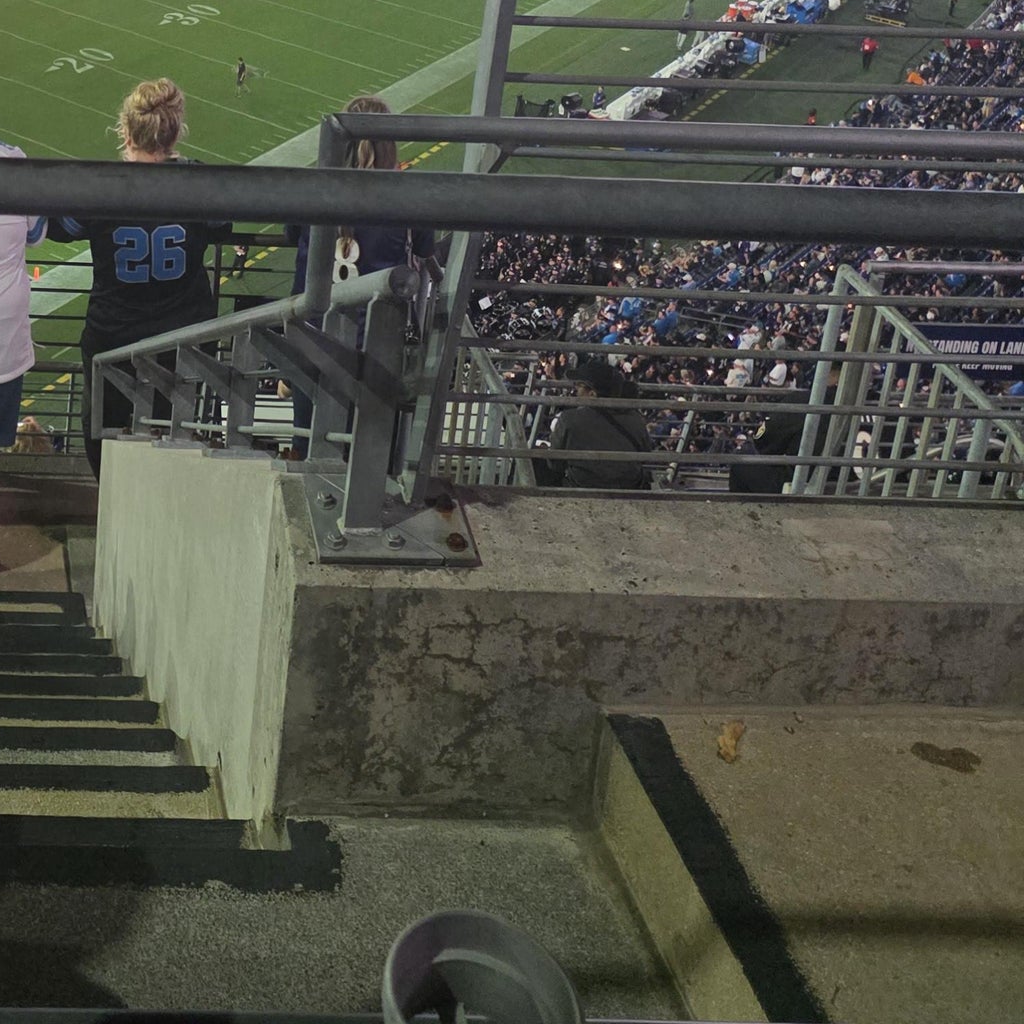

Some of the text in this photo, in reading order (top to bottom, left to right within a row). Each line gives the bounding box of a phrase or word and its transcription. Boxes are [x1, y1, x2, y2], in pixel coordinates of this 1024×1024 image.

[163, 3, 221, 26] 30
[58, 47, 114, 75] 20
[113, 224, 186, 284] 26
[333, 237, 361, 284] 8
[981, 341, 998, 355] ON
